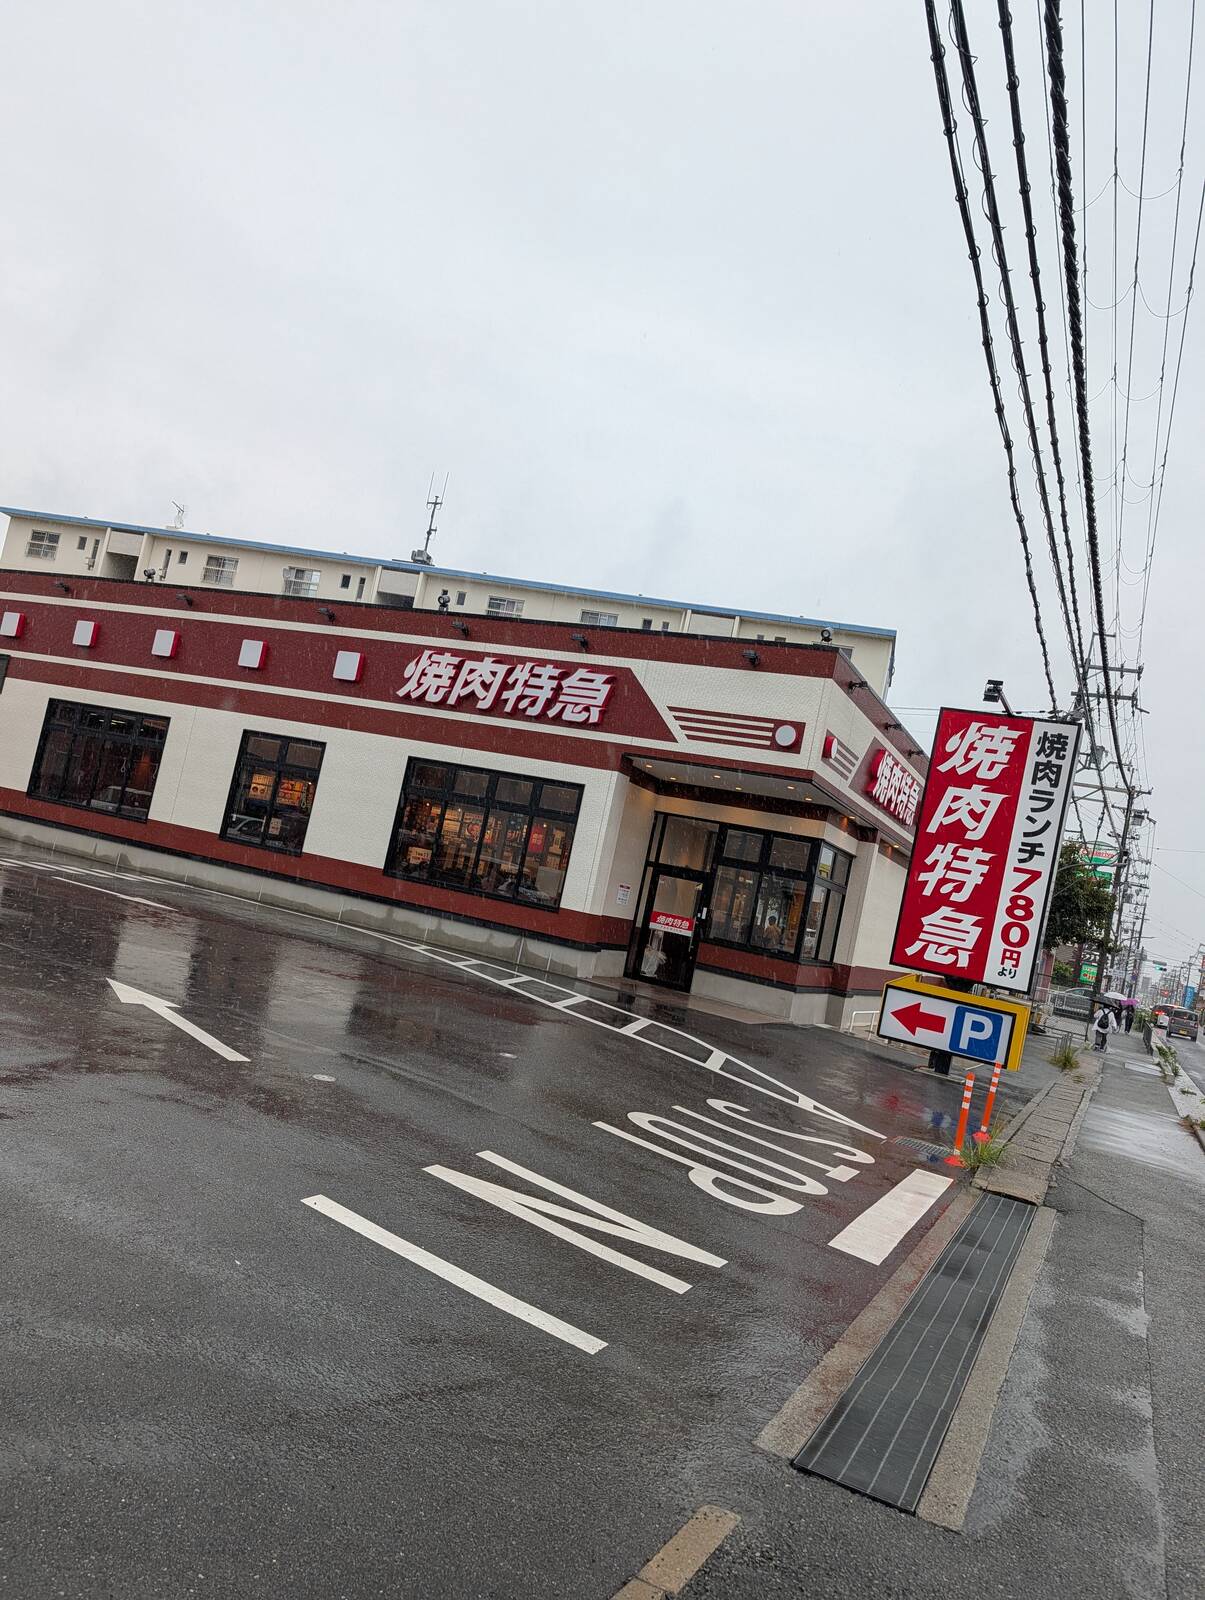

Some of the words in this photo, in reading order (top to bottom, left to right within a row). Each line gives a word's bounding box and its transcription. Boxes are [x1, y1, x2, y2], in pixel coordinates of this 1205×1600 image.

[396, 649, 612, 724] 焼肉特急
[872, 750, 920, 827] 焼肉特急
[904, 721, 1028, 969] 焼肉特急
[958, 1014, 994, 1051] P
[592, 1098, 876, 1215] STOP
